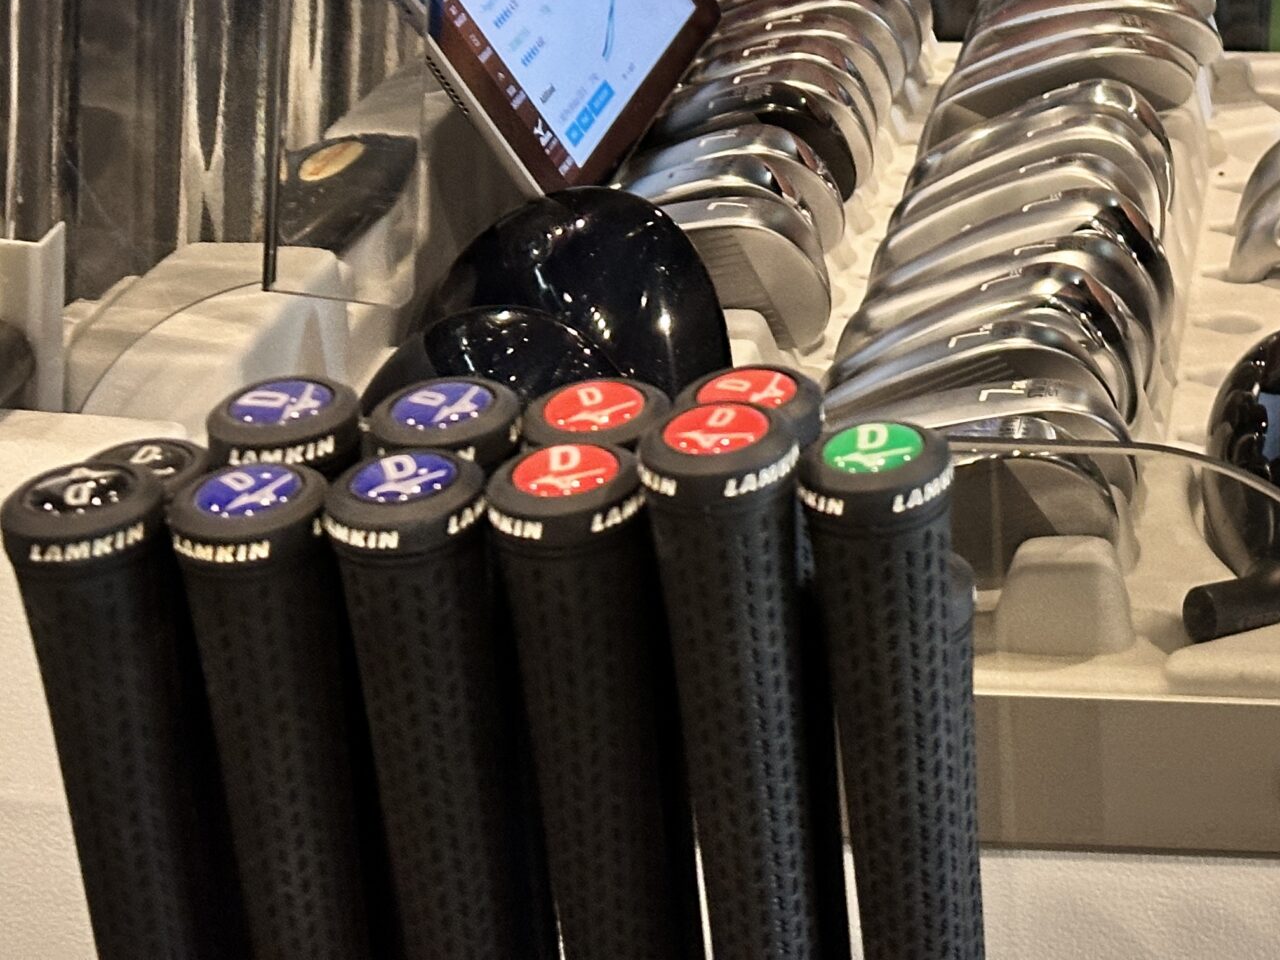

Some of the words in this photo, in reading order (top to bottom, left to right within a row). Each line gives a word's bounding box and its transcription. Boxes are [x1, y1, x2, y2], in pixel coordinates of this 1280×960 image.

[576, 387, 603, 407] D
[706, 408, 737, 428] D
[857, 422, 889, 450] D
[228, 435, 336, 467] LAMKIN
[549, 446, 581, 472] D
[219, 471, 255, 492] D
[380, 454, 417, 482] D
[797, 486, 844, 516] KIN
[29, 522, 144, 562] LAMKIN
[173, 534, 270, 563] LAMKIN
